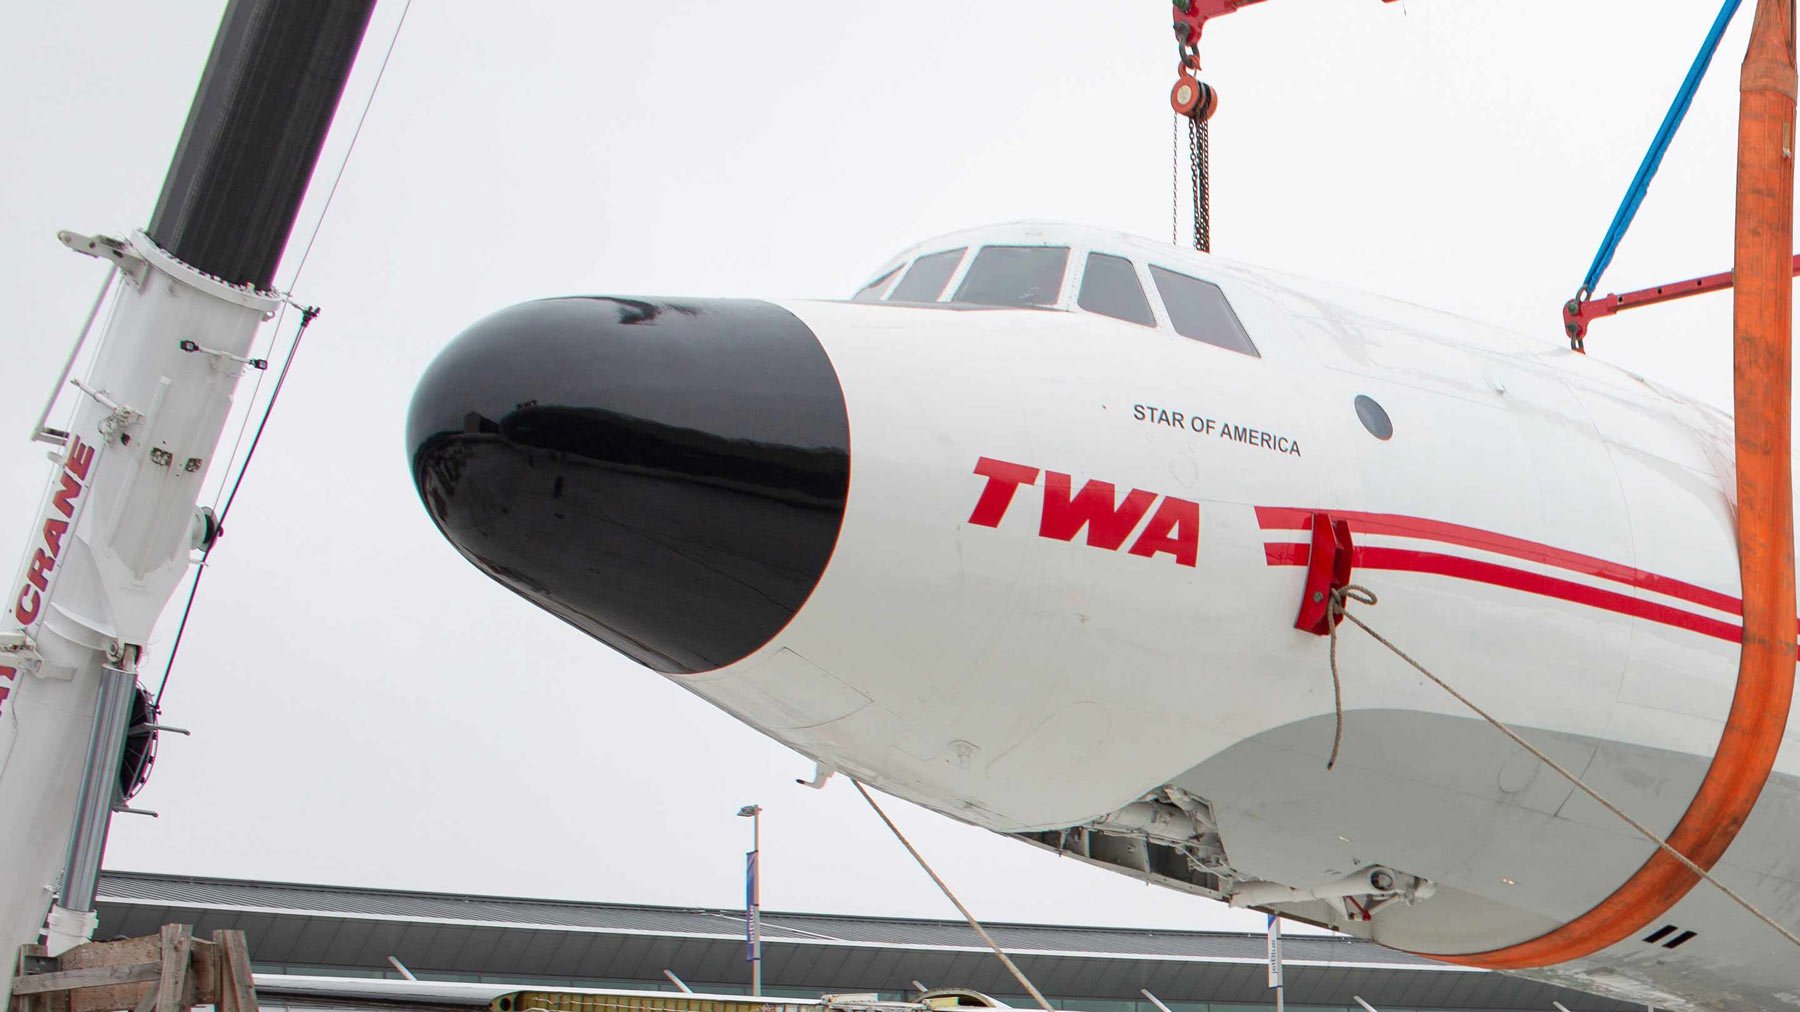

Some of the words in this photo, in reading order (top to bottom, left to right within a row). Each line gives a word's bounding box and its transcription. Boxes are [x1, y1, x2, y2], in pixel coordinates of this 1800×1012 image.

[1133, 404, 1185, 429] STAR
[1191, 416, 1216, 435] OF
[1220, 423, 1302, 457] AMERICA
[16, 434, 95, 625] CRANE
[968, 456, 1200, 568] TWA
